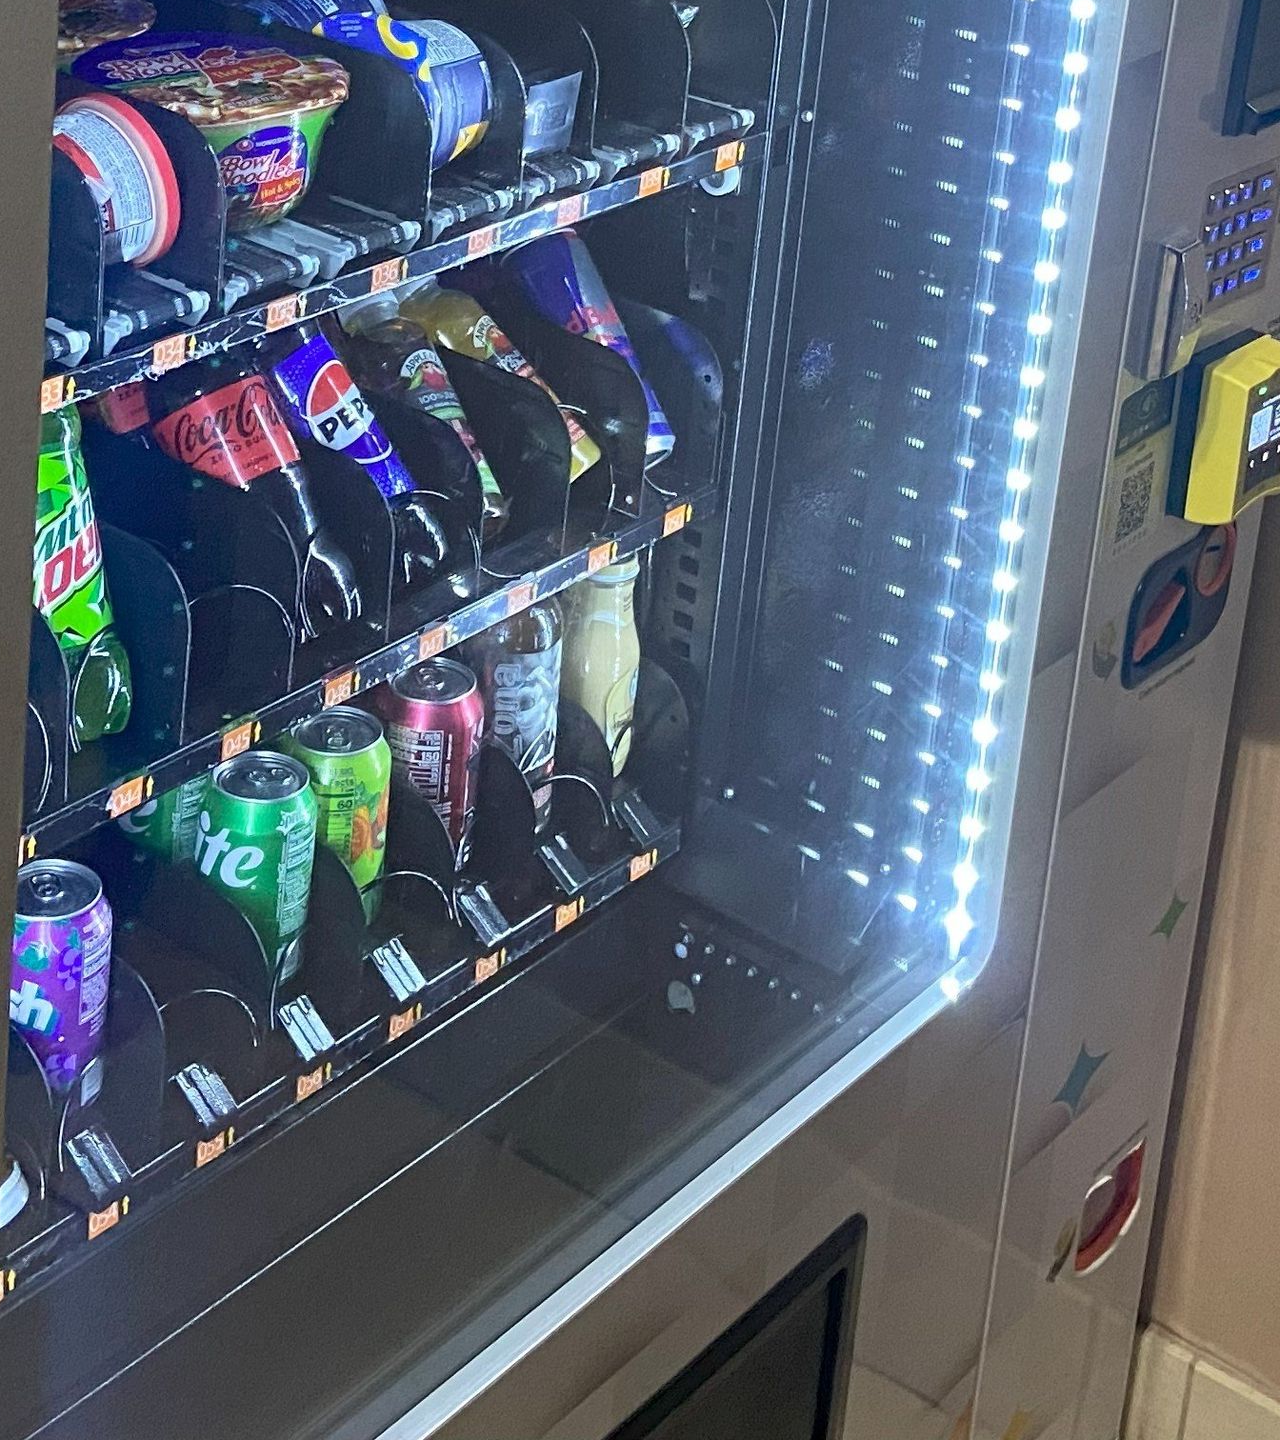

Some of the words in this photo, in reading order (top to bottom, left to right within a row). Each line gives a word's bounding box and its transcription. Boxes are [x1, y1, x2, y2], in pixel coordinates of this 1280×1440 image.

[220, 148, 280, 174] Bowl
[261, 188, 276, 200] Hot
[372, 265, 398, 287] 036
[154, 341, 184, 367] 034
[42, 380, 62, 407] 33
[317, 398, 366, 444] PEP
[420, 633, 444, 657] 047
[324, 680, 353, 707] 046
[224, 726, 252, 754] 045
[421, 751, 440, 761] 150
[112, 781, 142, 809] 044
[337, 799, 353, 809] 60
[195, 810, 266, 889] ite
